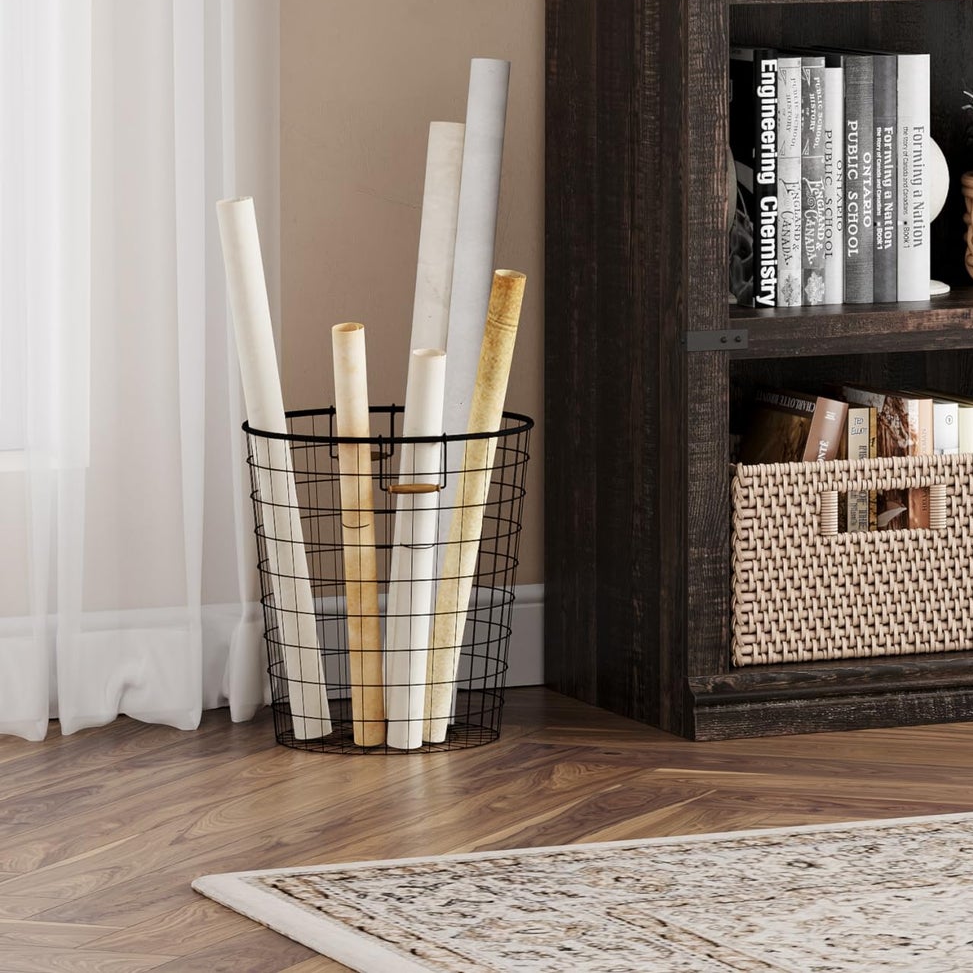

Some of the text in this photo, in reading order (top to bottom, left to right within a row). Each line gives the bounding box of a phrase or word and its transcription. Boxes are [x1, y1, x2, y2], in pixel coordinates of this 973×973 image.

[813, 77, 823, 148] PUBLIC SCHOOL
[756, 59, 778, 307] Engineering Chemistry
[803, 178, 825, 251] ENGLAND &
[824, 130, 833, 259] PUBLIC SCHOOL
[848, 120, 858, 257] PUBLIC SCHOOL
[863, 152, 871, 227] ONTARIO
[882, 126, 893, 249] Forming a Nation
[910, 126, 925, 247] Forming a Nation
